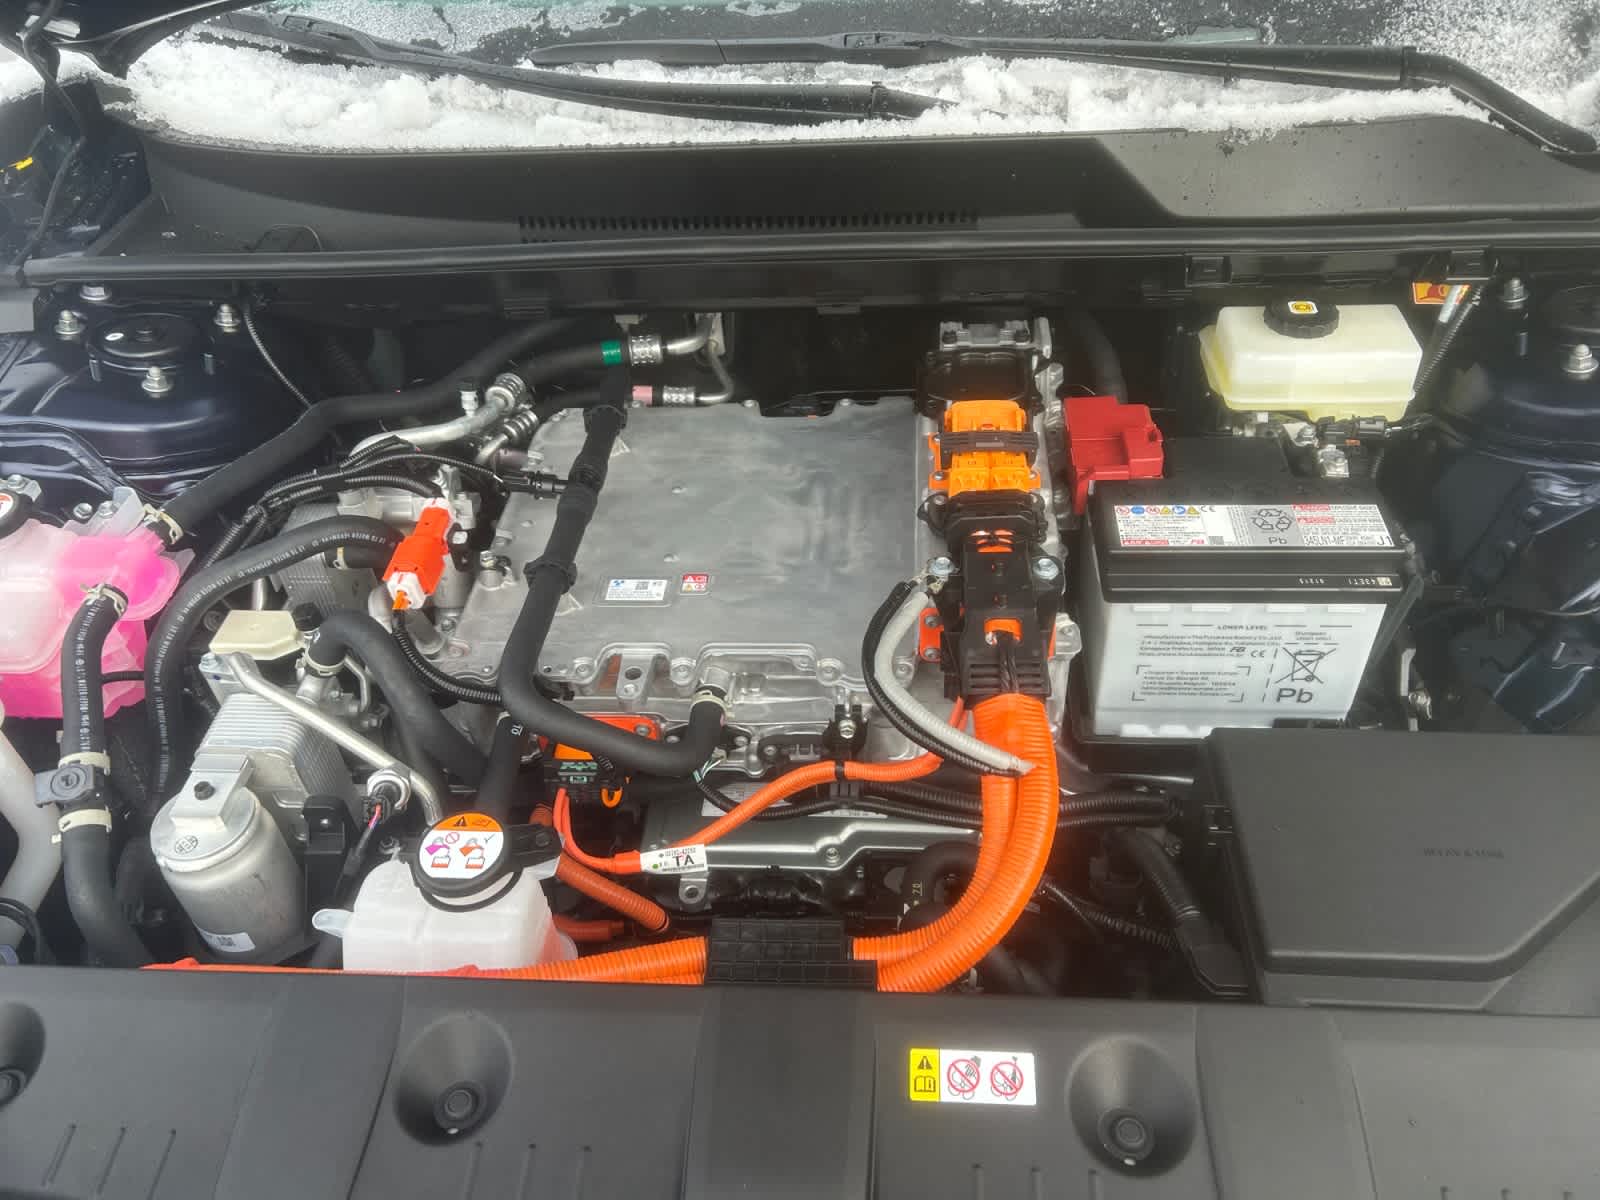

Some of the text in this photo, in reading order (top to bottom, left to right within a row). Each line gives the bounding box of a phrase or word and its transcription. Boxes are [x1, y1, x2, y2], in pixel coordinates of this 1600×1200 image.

[1268, 537, 1287, 545] Pb
[1275, 687, 1314, 704] Pb
[672, 854, 695, 867] TA
